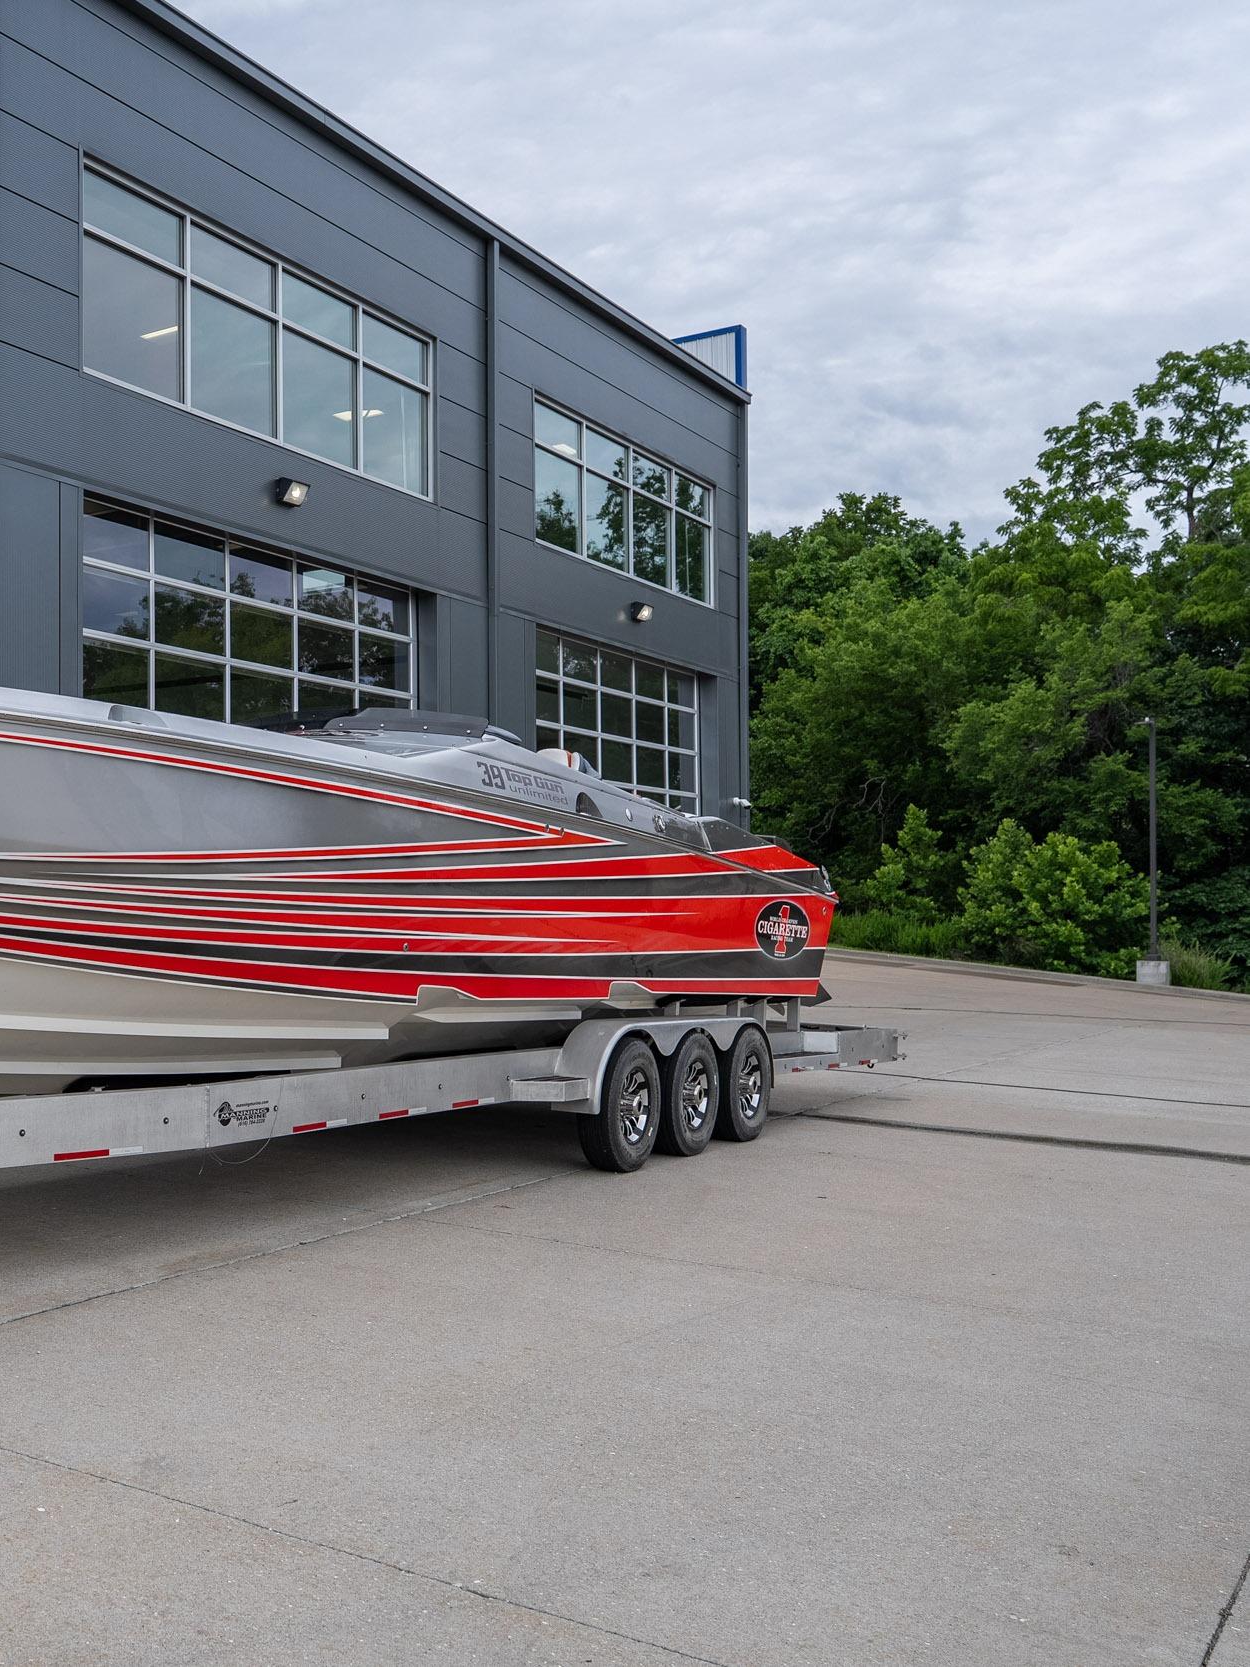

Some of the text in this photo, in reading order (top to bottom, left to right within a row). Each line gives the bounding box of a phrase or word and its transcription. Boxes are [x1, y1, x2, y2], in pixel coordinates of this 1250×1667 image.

[476, 761, 565, 795] 39 Top Gun
[509, 784, 569, 806] unlimited
[758, 920, 808, 939] CIGARETTE
[220, 1108, 268, 1119] MANNING
[236, 1112, 267, 1121] MARINE
